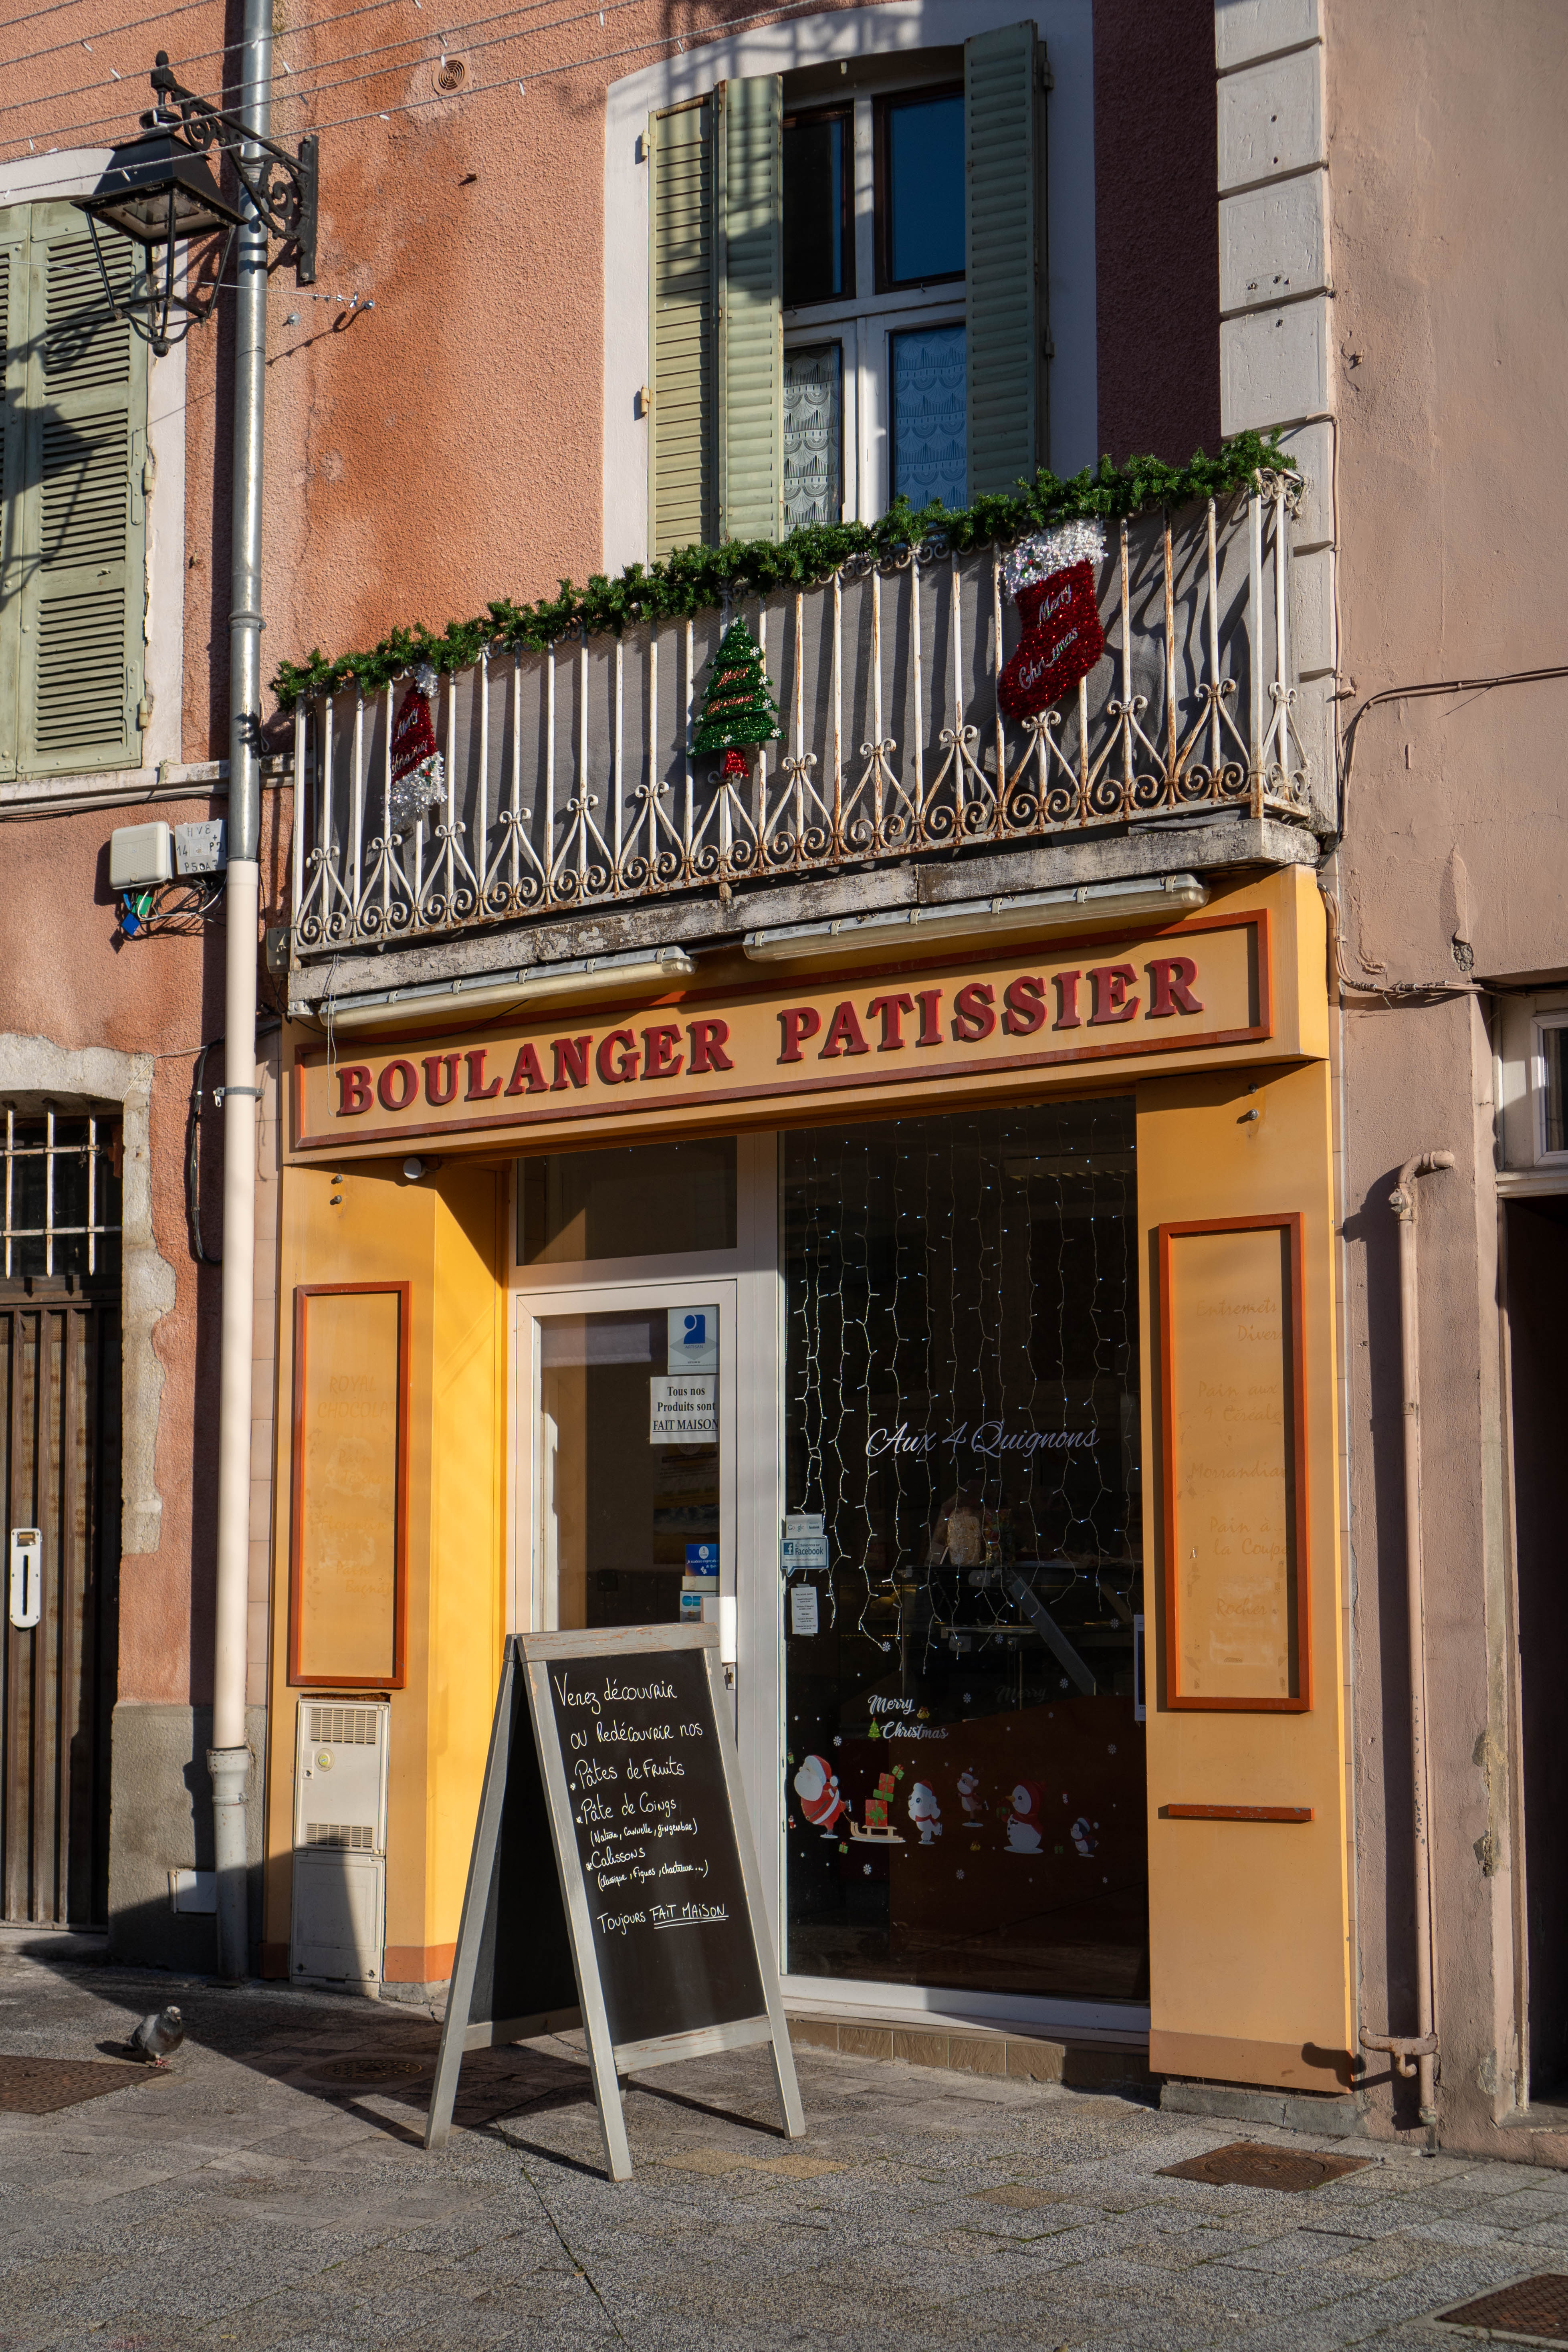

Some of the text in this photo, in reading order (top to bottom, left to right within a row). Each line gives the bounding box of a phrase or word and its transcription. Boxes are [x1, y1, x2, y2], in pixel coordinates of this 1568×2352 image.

[1037, 583, 1072, 628] Merry
[176, 844, 188, 856] 14
[339, 956, 1205, 1114] BOULANGER PATISSIER
[667, 1386, 705, 1396] Tous nos
[657, 1401, 716, 1412] Produits sont
[653, 1418, 719, 1431] FAIT MAISON
[866, 1421, 1100, 1458] Aux 4 Quignons
[795, 1547, 824, 1555] Facebook
[554, 1672, 678, 1715] Venez découvrir
[867, 1695, 916, 1715] Merry
[680, 1723, 703, 1738] nos
[880, 1721, 949, 1740] Christmas
[575, 1756, 685, 1789] Pâtes de Fruits
[581, 1792, 676, 1825] Pâte de Coings
[591, 1846, 646, 1869] Calissons
